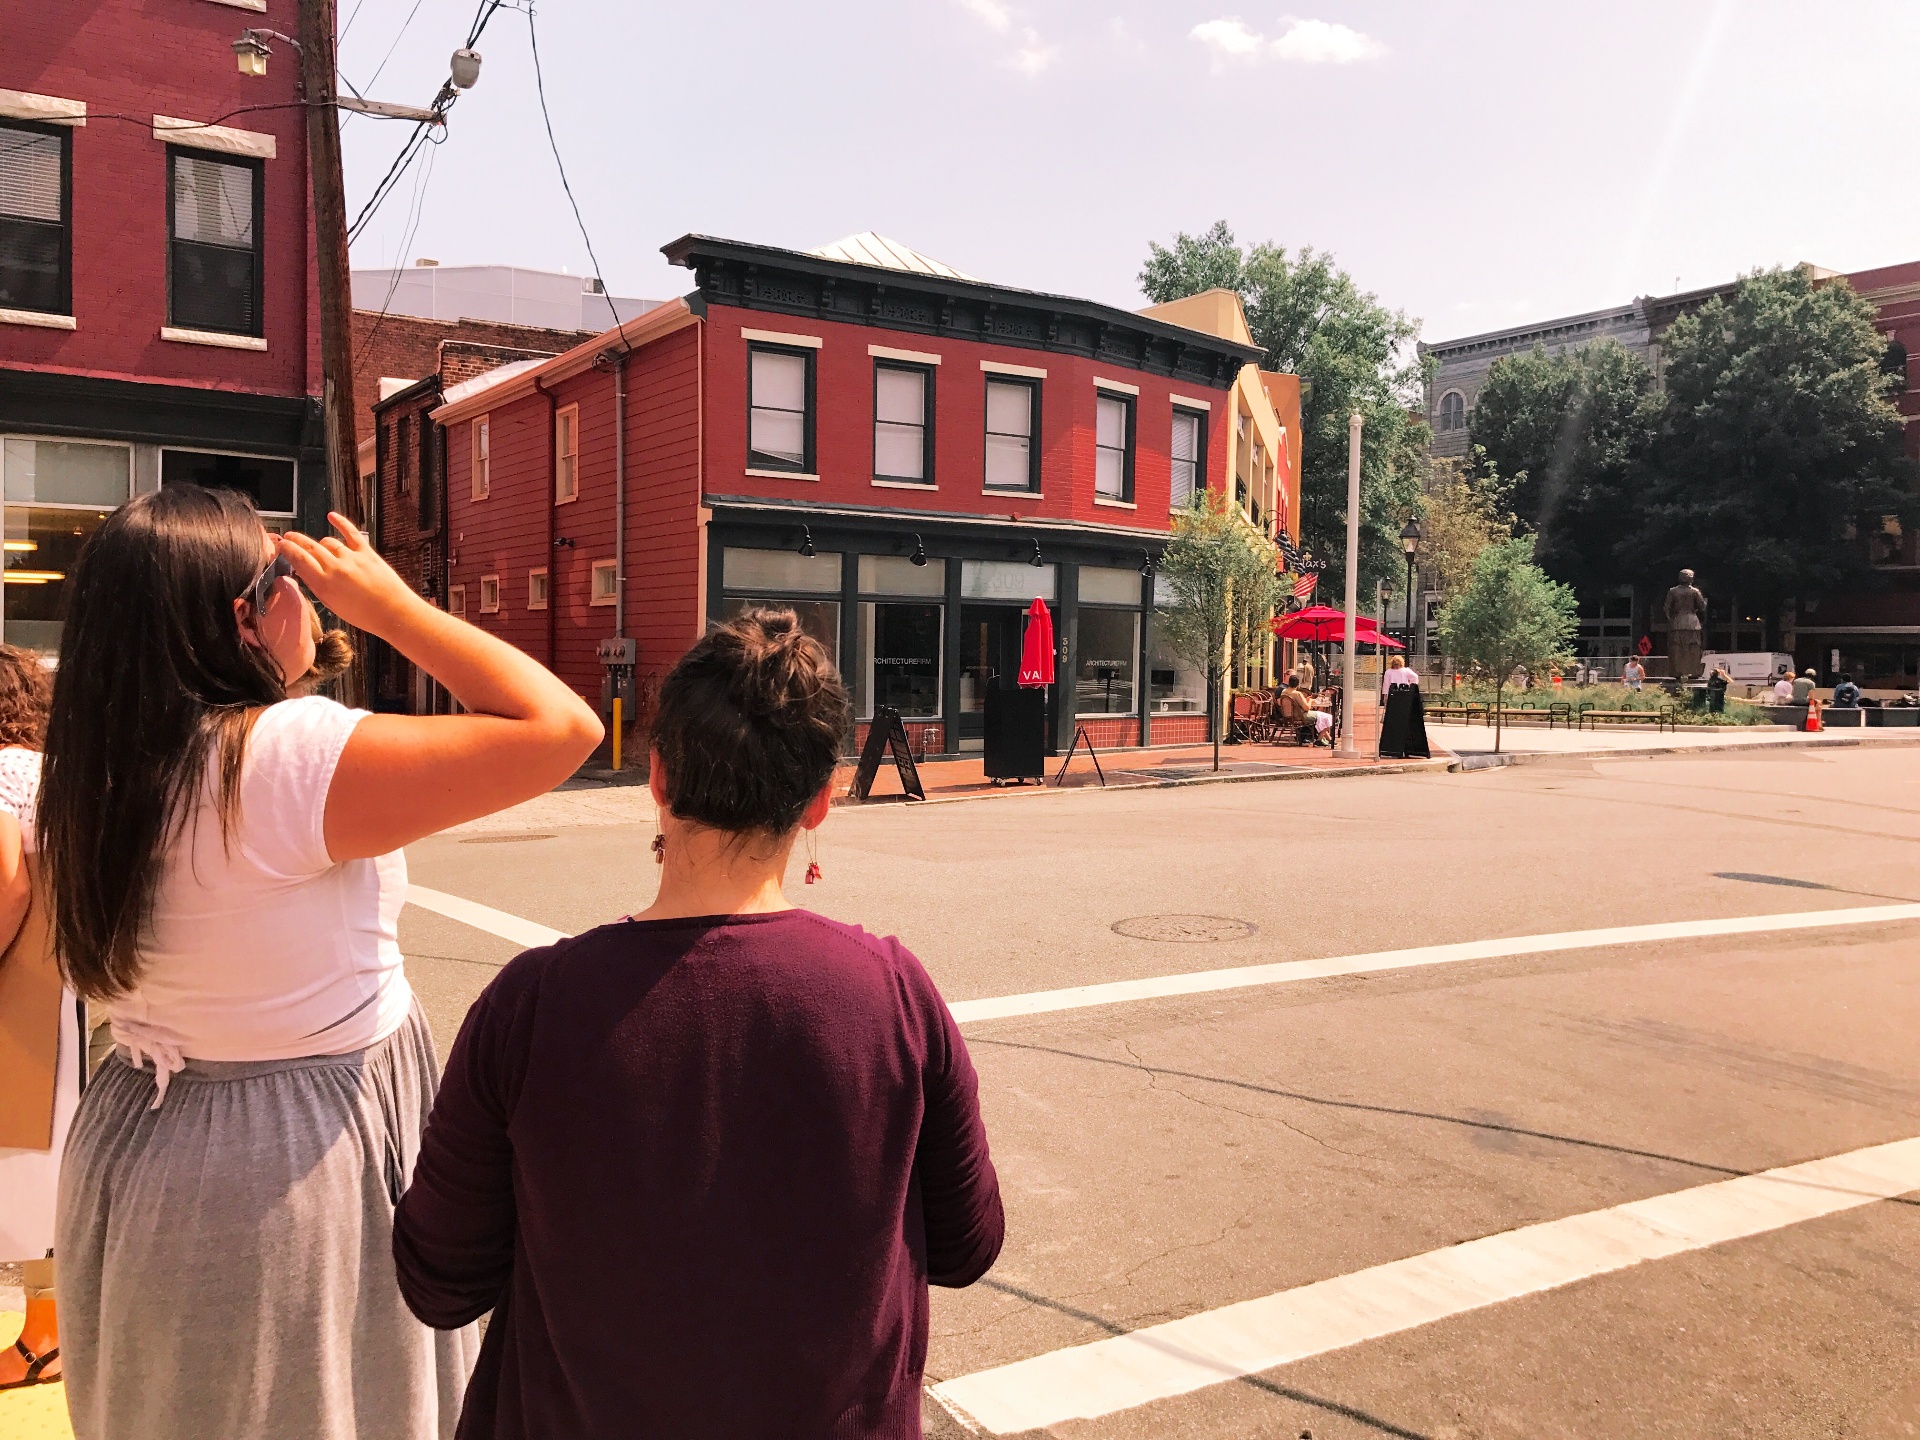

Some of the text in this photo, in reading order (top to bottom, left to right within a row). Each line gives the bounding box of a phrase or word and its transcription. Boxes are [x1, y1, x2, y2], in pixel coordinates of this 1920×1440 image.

[992, 572, 1025, 590] 309
[874, 657, 932, 665] RCHITECTUREFIRM
[1022, 670, 1042, 681] VA
